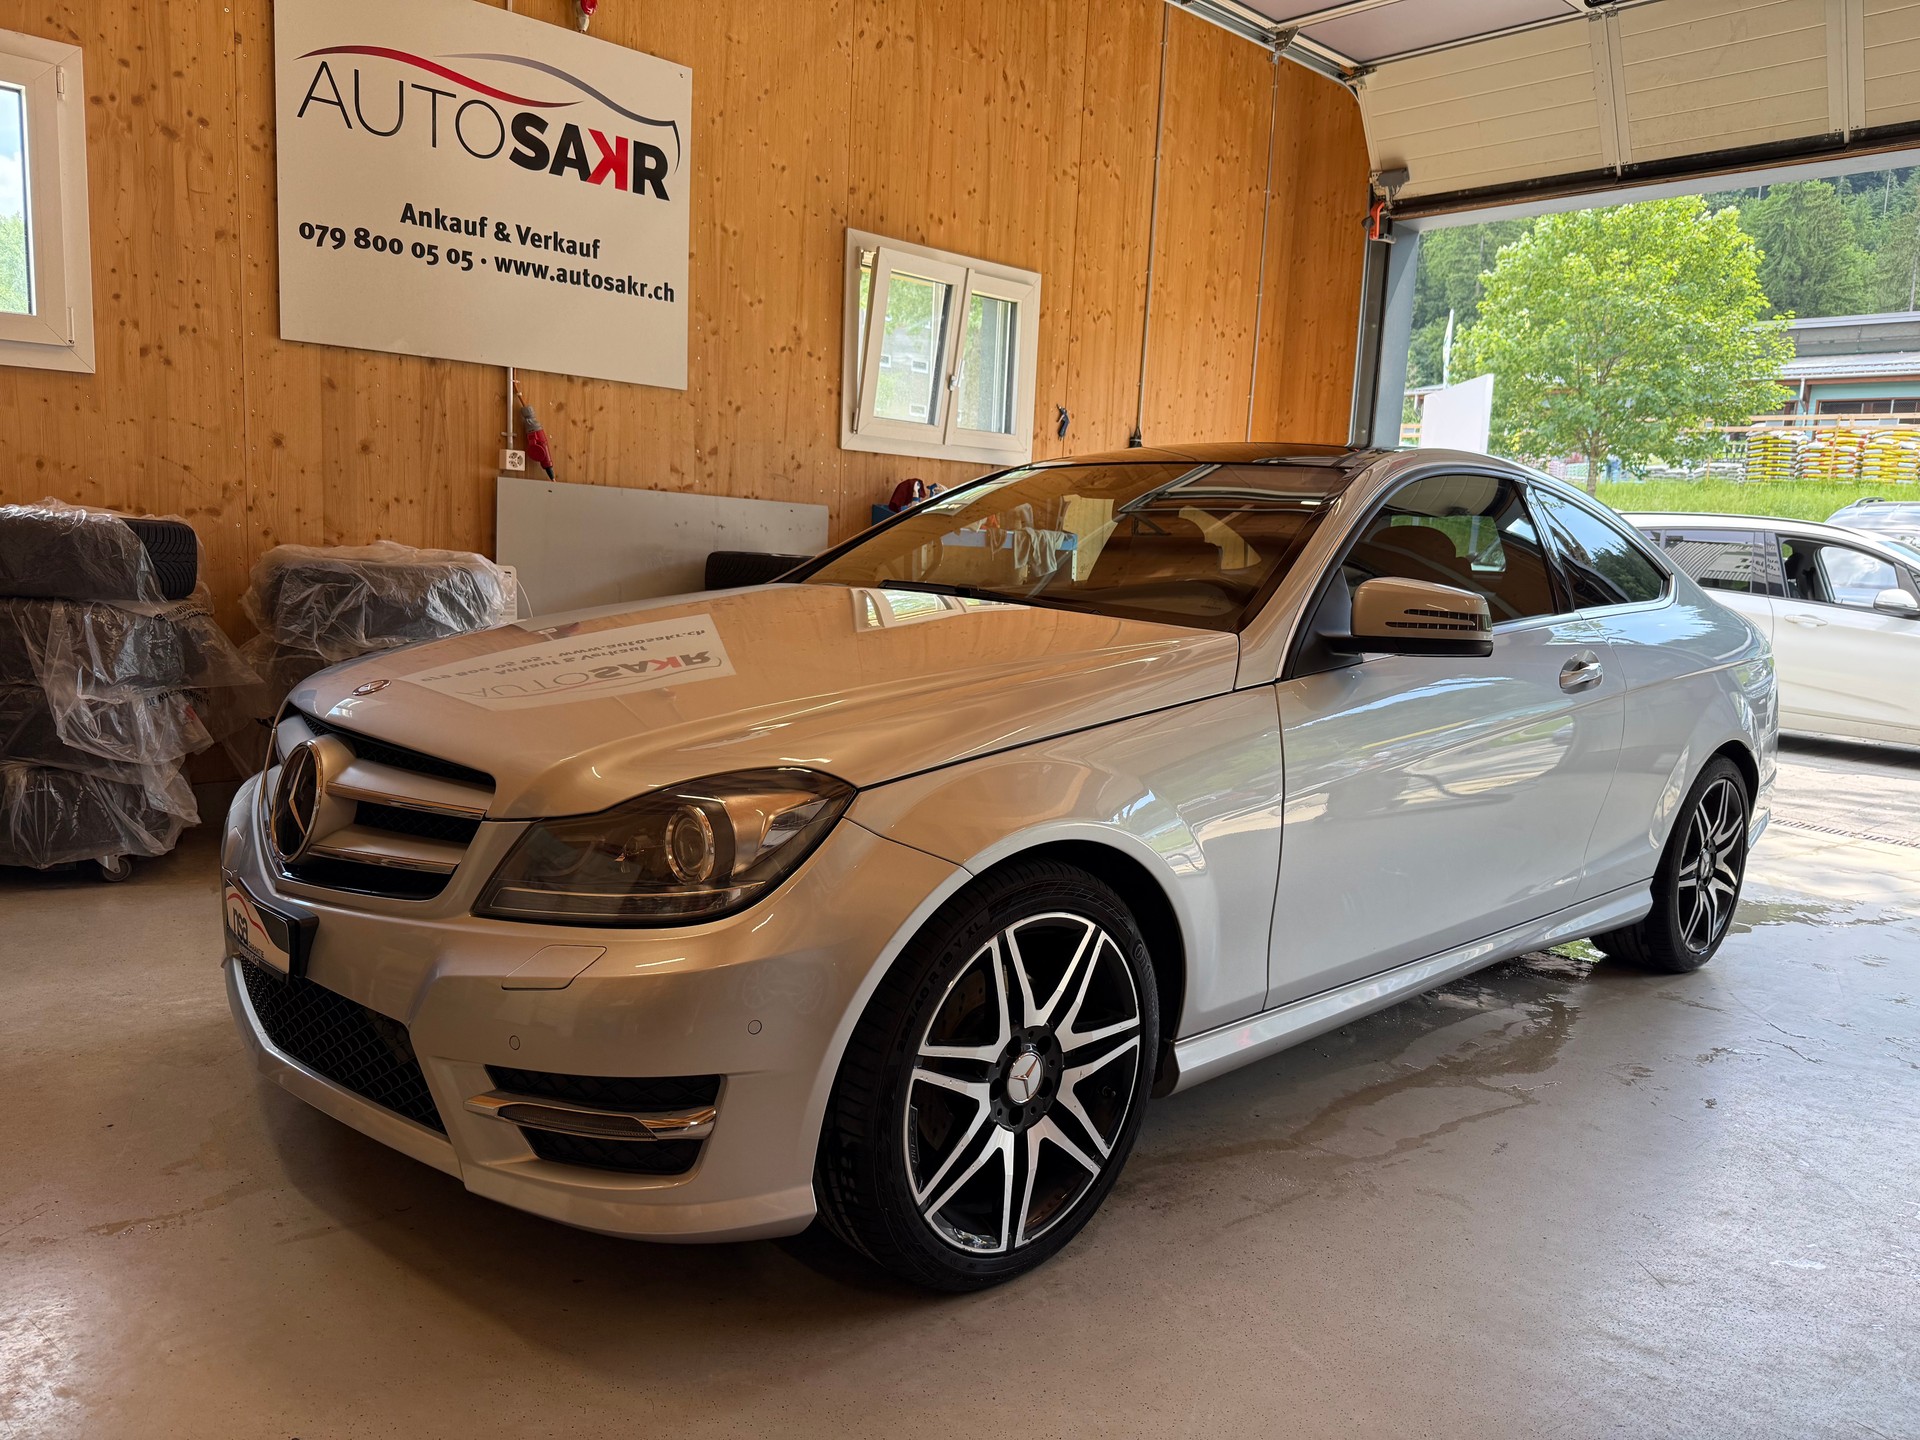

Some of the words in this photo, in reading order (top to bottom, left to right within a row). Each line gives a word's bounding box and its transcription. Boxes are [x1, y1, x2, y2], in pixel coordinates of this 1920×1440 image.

[296, 60, 671, 202] AUTOSAKR
[298, 221, 347, 251] 079
[353, 227, 404, 256] 800
[410, 241, 440, 266] 05
[446, 247, 474, 272] 05
[493, 255, 676, 303] www.autosakr.ch
[399, 202, 489, 239] Ankauf
[493, 221, 512, 244] &
[515, 223, 601, 260] Verkauf
[965, 921, 984, 938] XL
